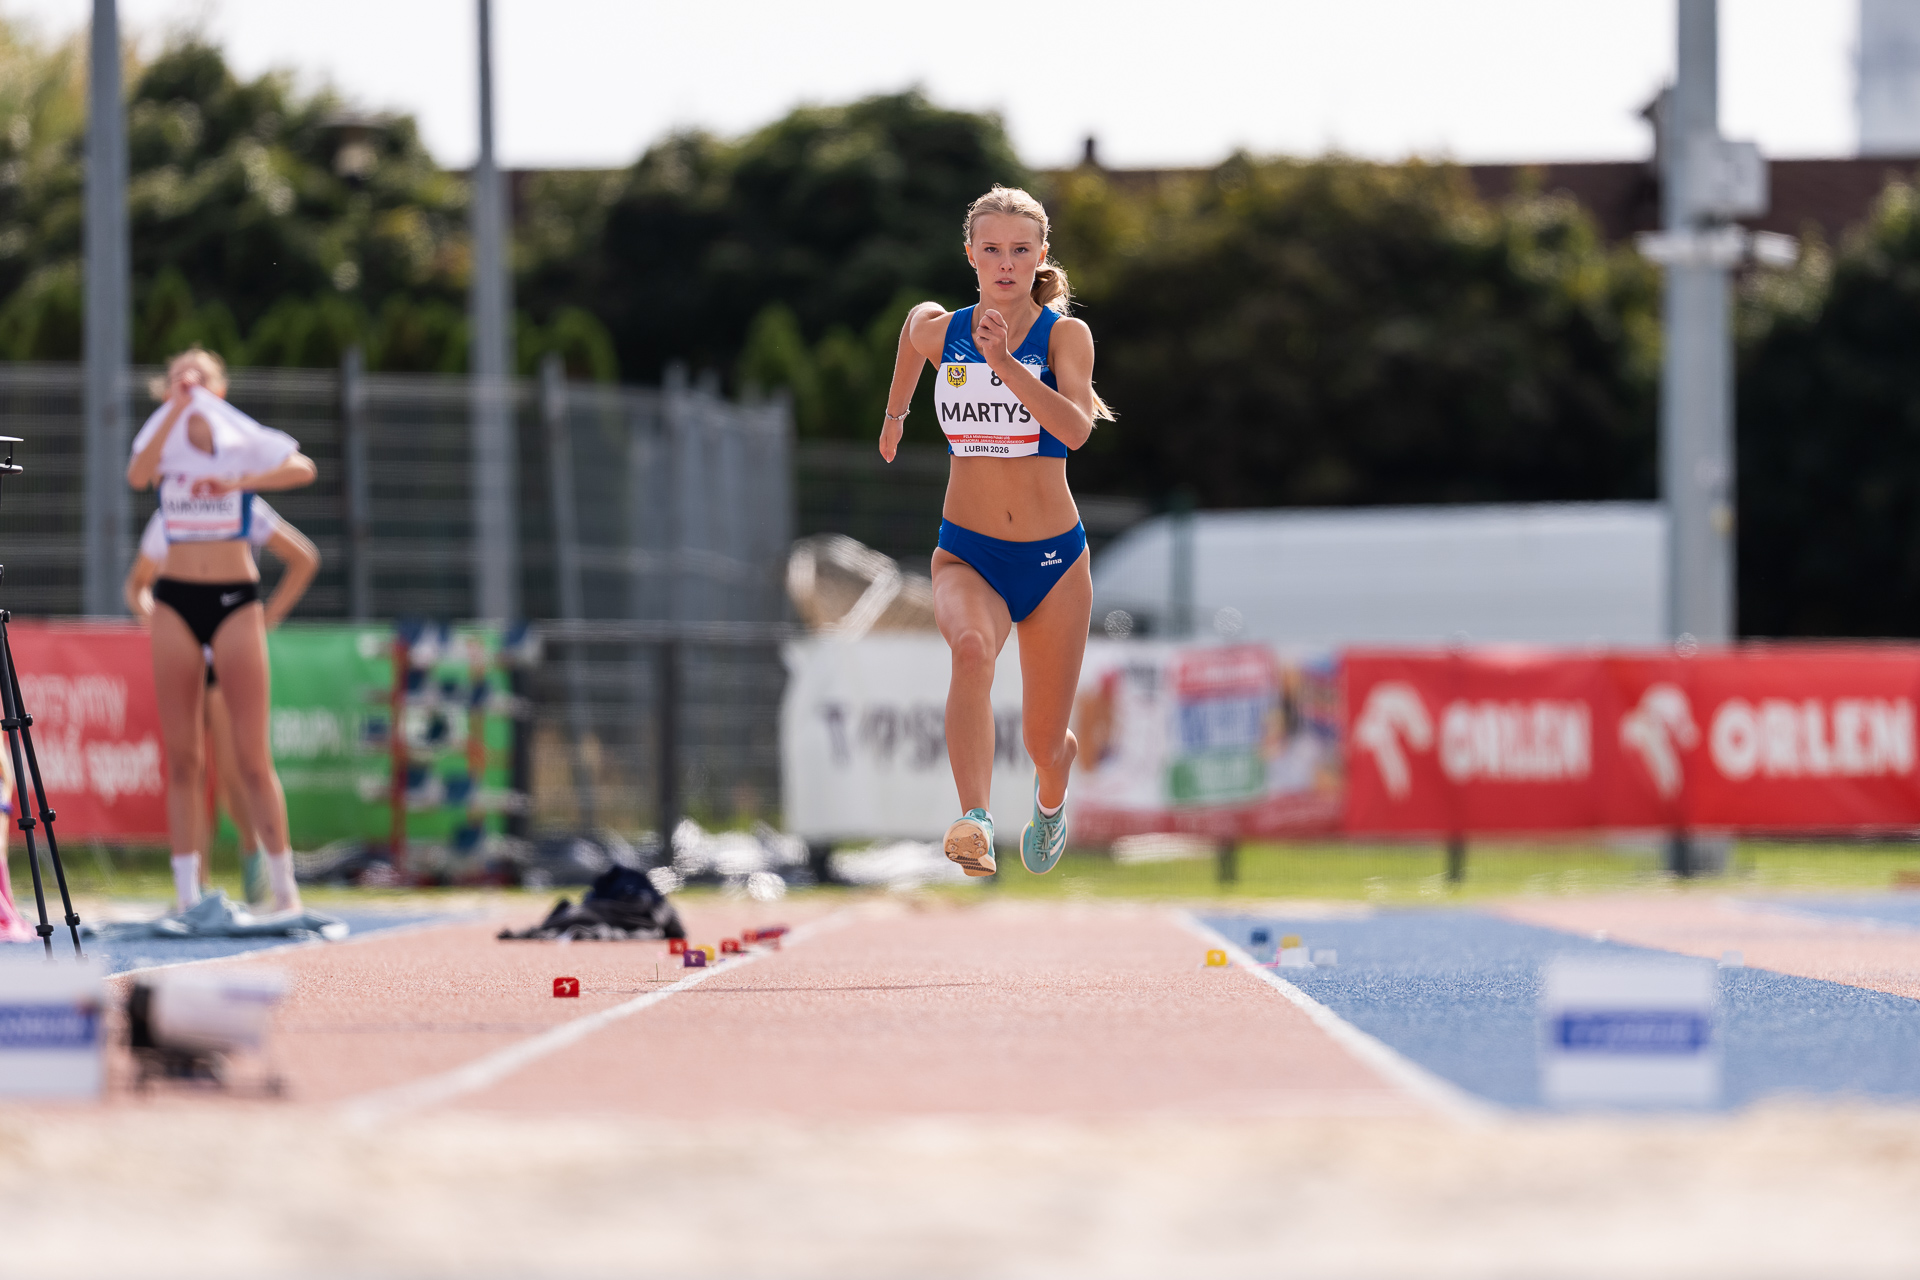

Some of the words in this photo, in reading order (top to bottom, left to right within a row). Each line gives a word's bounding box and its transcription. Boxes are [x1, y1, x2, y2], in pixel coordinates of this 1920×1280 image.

[942, 402, 1031, 423] MARTYS
[964, 445, 989, 453] LUBIN
[990, 446, 1010, 454] 2026
[1439, 700, 1592, 783] ORLEN
[1709, 698, 1917, 781] ORLEN
